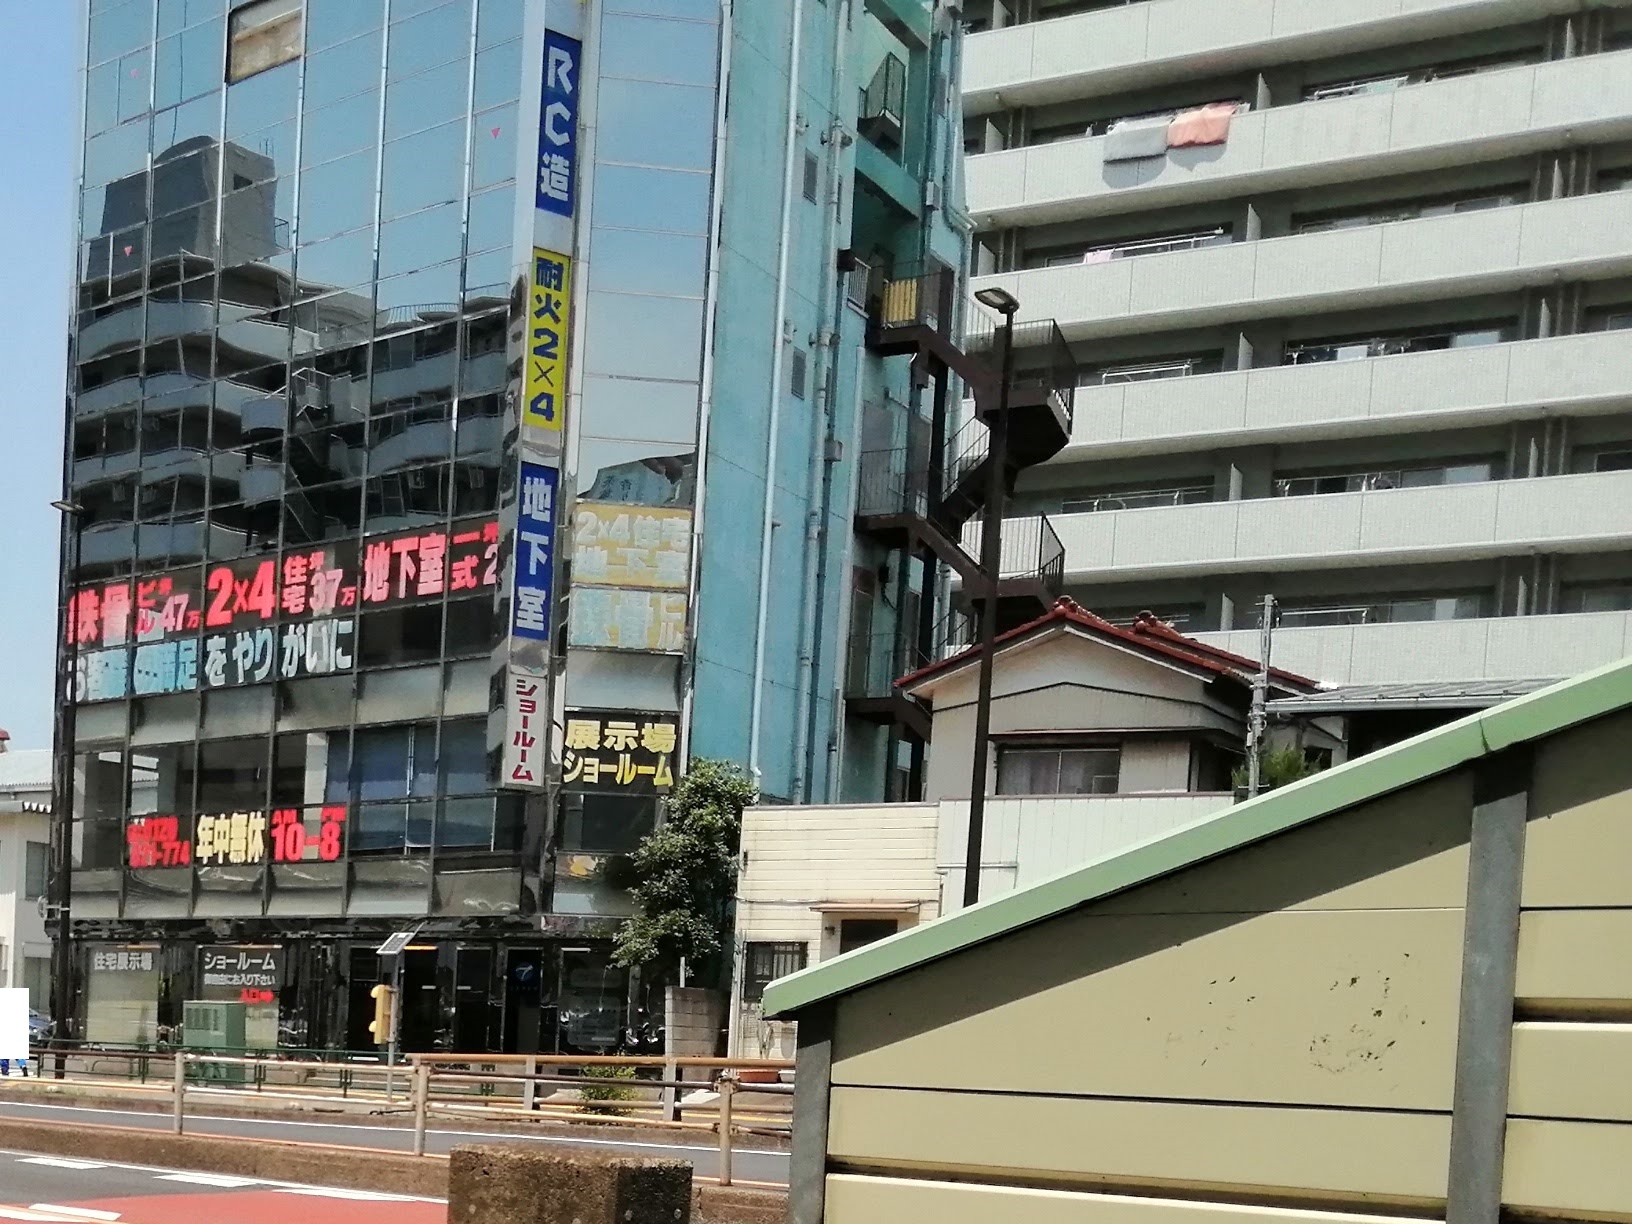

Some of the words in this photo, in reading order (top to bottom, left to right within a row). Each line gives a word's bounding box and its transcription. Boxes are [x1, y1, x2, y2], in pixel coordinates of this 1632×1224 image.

[541, 46, 574, 202] RC造
[515, 476, 553, 632] 地下室
[511, 679, 538, 781] ショールーム
[565, 719, 676, 753] 展示場
[563, 750, 674, 787] ショールーム
[196, 811, 266, 864] 年中無休
[94, 952, 153, 972] 住宅展示場
[204, 952, 276, 971] ショールーム
